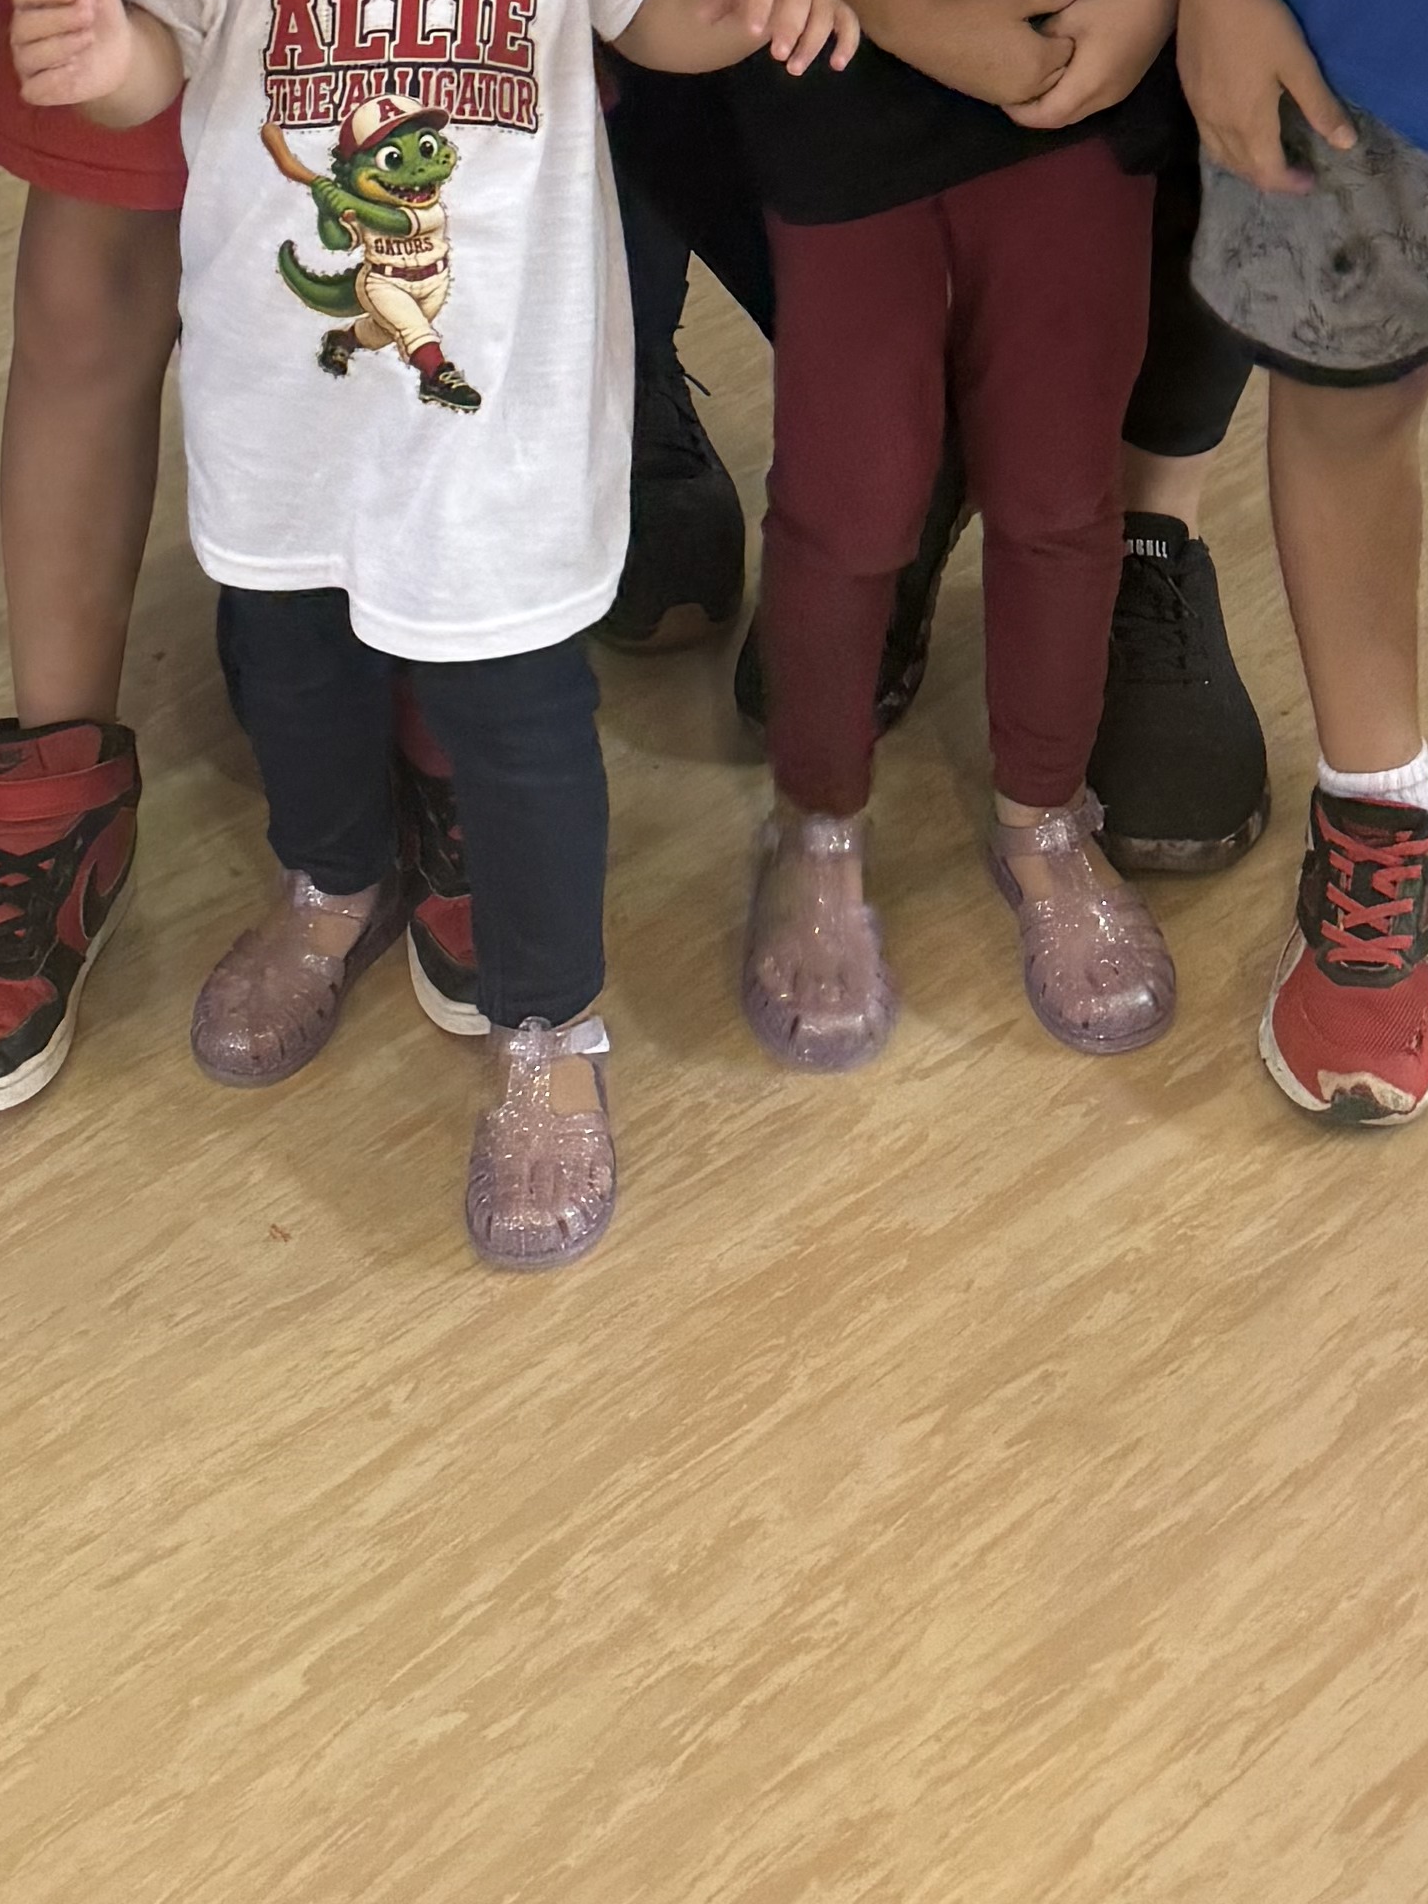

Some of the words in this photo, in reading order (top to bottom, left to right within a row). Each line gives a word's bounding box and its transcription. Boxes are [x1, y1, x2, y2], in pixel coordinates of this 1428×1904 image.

[267, 72, 336, 125] THE
[375, 97, 402, 123] A
[373, 236, 435, 257] GATORS
